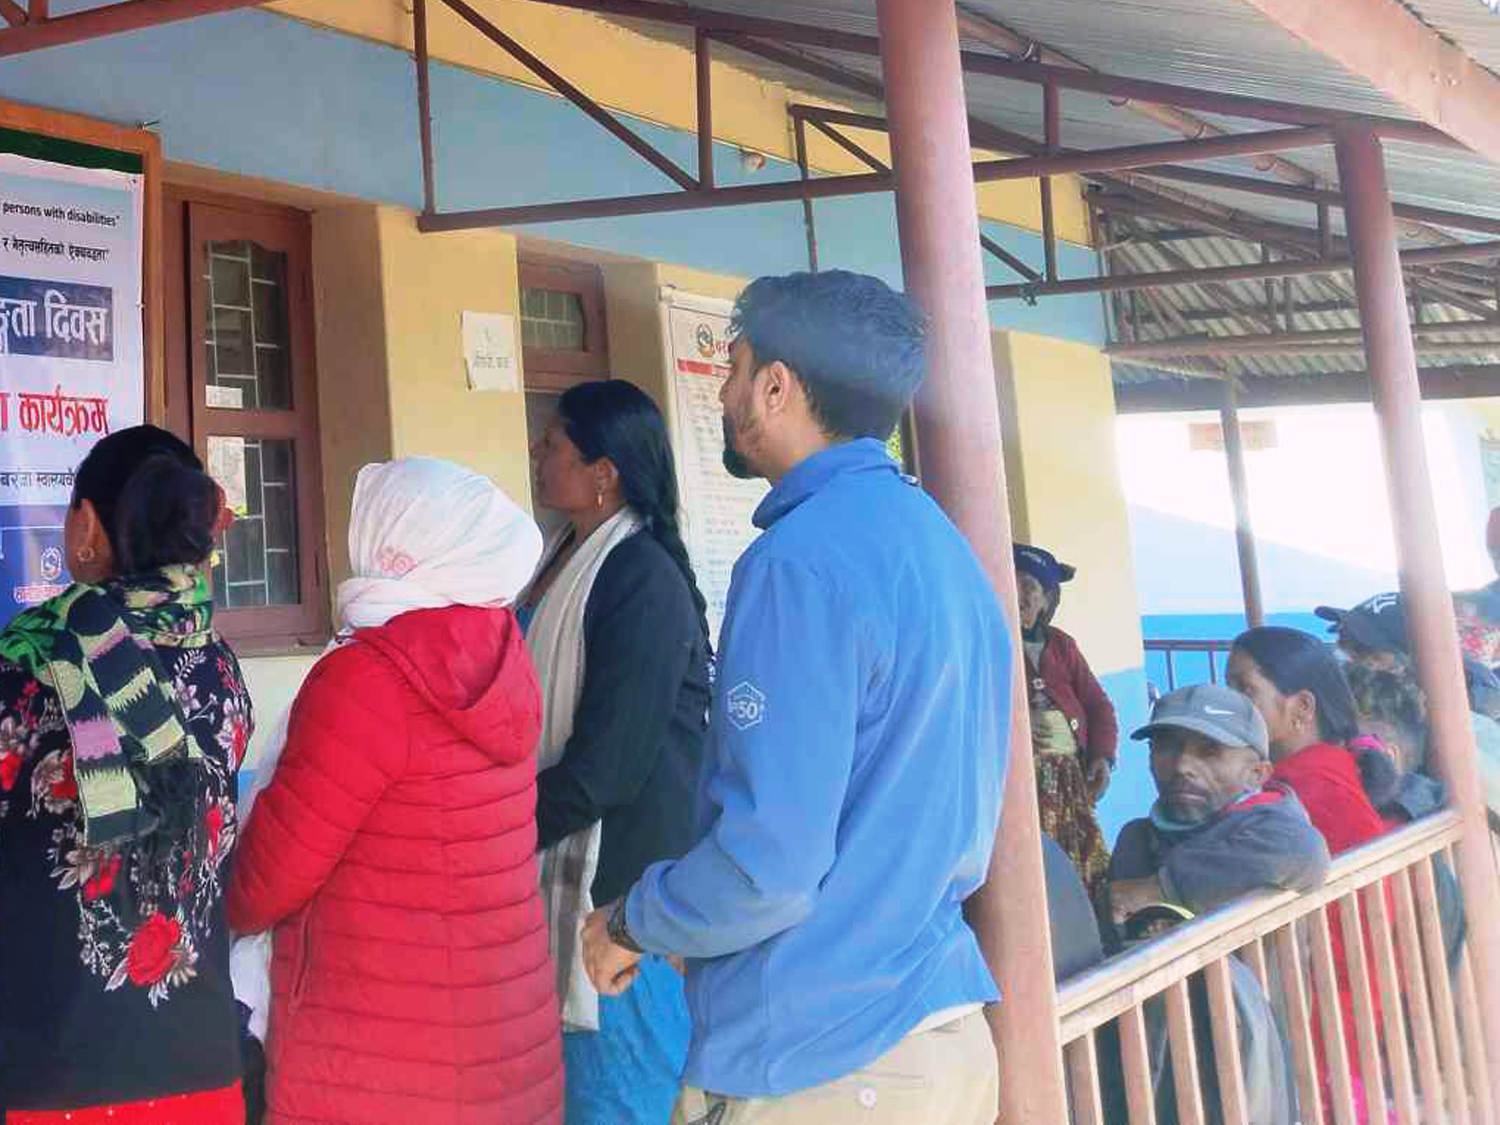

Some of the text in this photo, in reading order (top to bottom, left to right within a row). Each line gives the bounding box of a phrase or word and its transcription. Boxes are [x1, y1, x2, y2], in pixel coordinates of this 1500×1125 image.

[3, 202, 42, 217] persons
[44, 206, 65, 220] with
[44, 289, 108, 345] दिवस
[18, 385, 111, 438] कार्यक्रम
